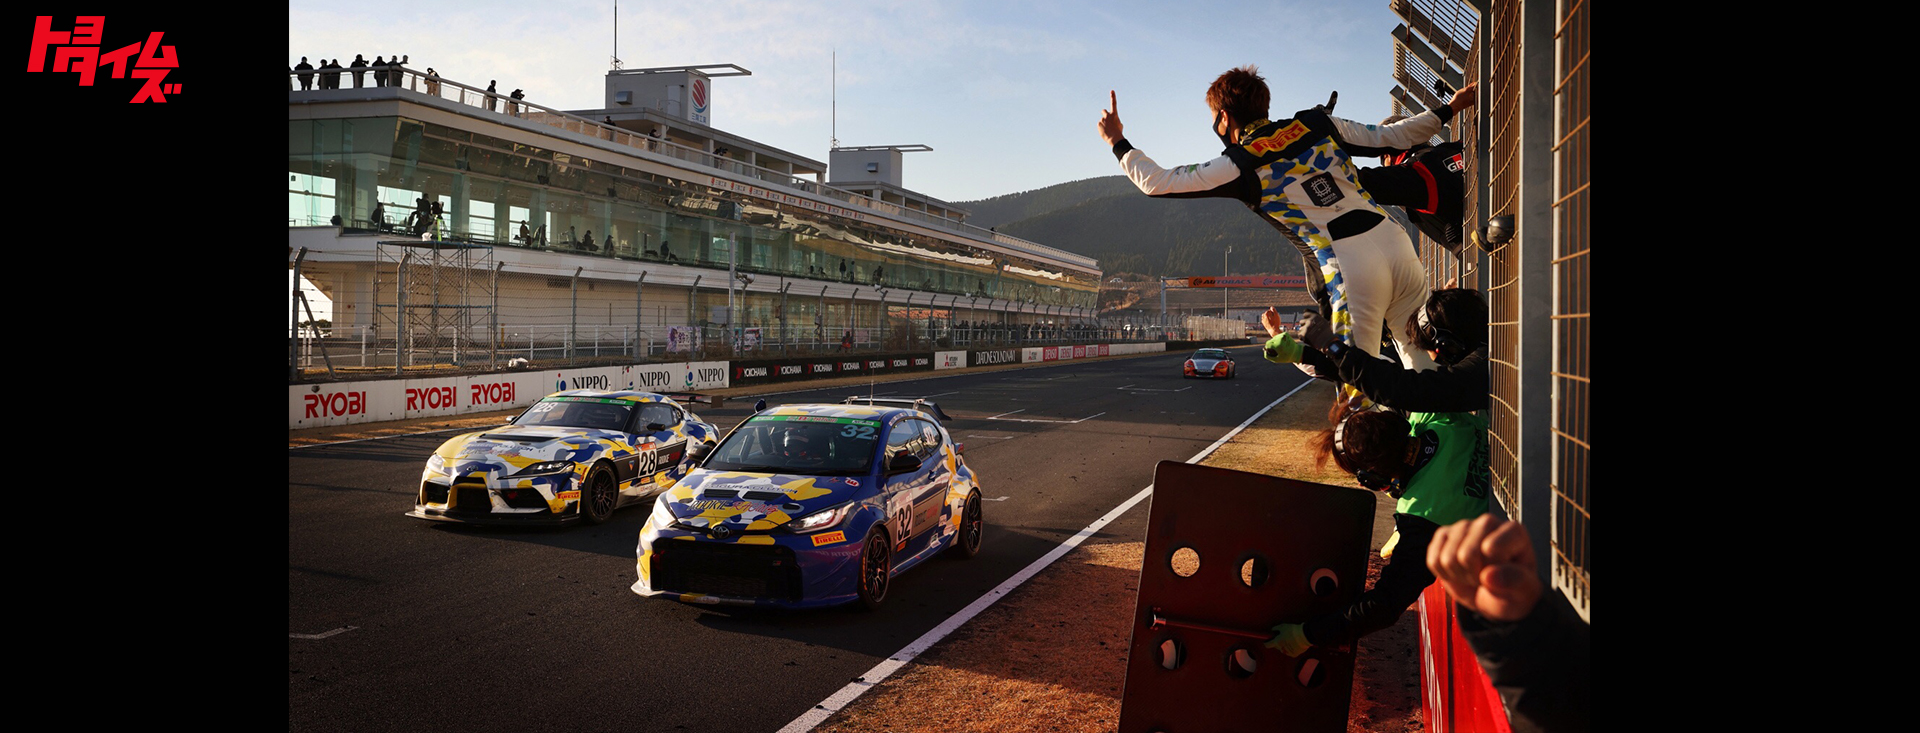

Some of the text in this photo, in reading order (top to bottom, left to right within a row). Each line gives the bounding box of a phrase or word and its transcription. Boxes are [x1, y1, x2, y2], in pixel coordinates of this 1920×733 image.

[1251, 123, 1304, 153] PIRELLI
[1447, 160, 1464, 172] GR
[743, 367, 767, 377] YOKOHAMA
[780, 365, 802, 375] YOKOHAMA
[813, 363, 833, 373] YOKOHAMA
[842, 362, 860, 371] YOKOHAMA
[572, 374, 608, 391] NIPPO
[639, 370, 671, 388] NIPPO
[697, 367, 725, 383] NIPPO
[406, 386, 457, 411] RYOBI
[471, 382, 516, 406] RYOBI
[304, 391, 367, 419] RYOBI
[532, 402, 559, 413] 28
[841, 424, 875, 440] 32
[639, 450, 656, 476] 28
[557, 491, 580, 500] PIRELLI
[897, 504, 912, 541] 32
[814, 532, 844, 545] PIRELLI
